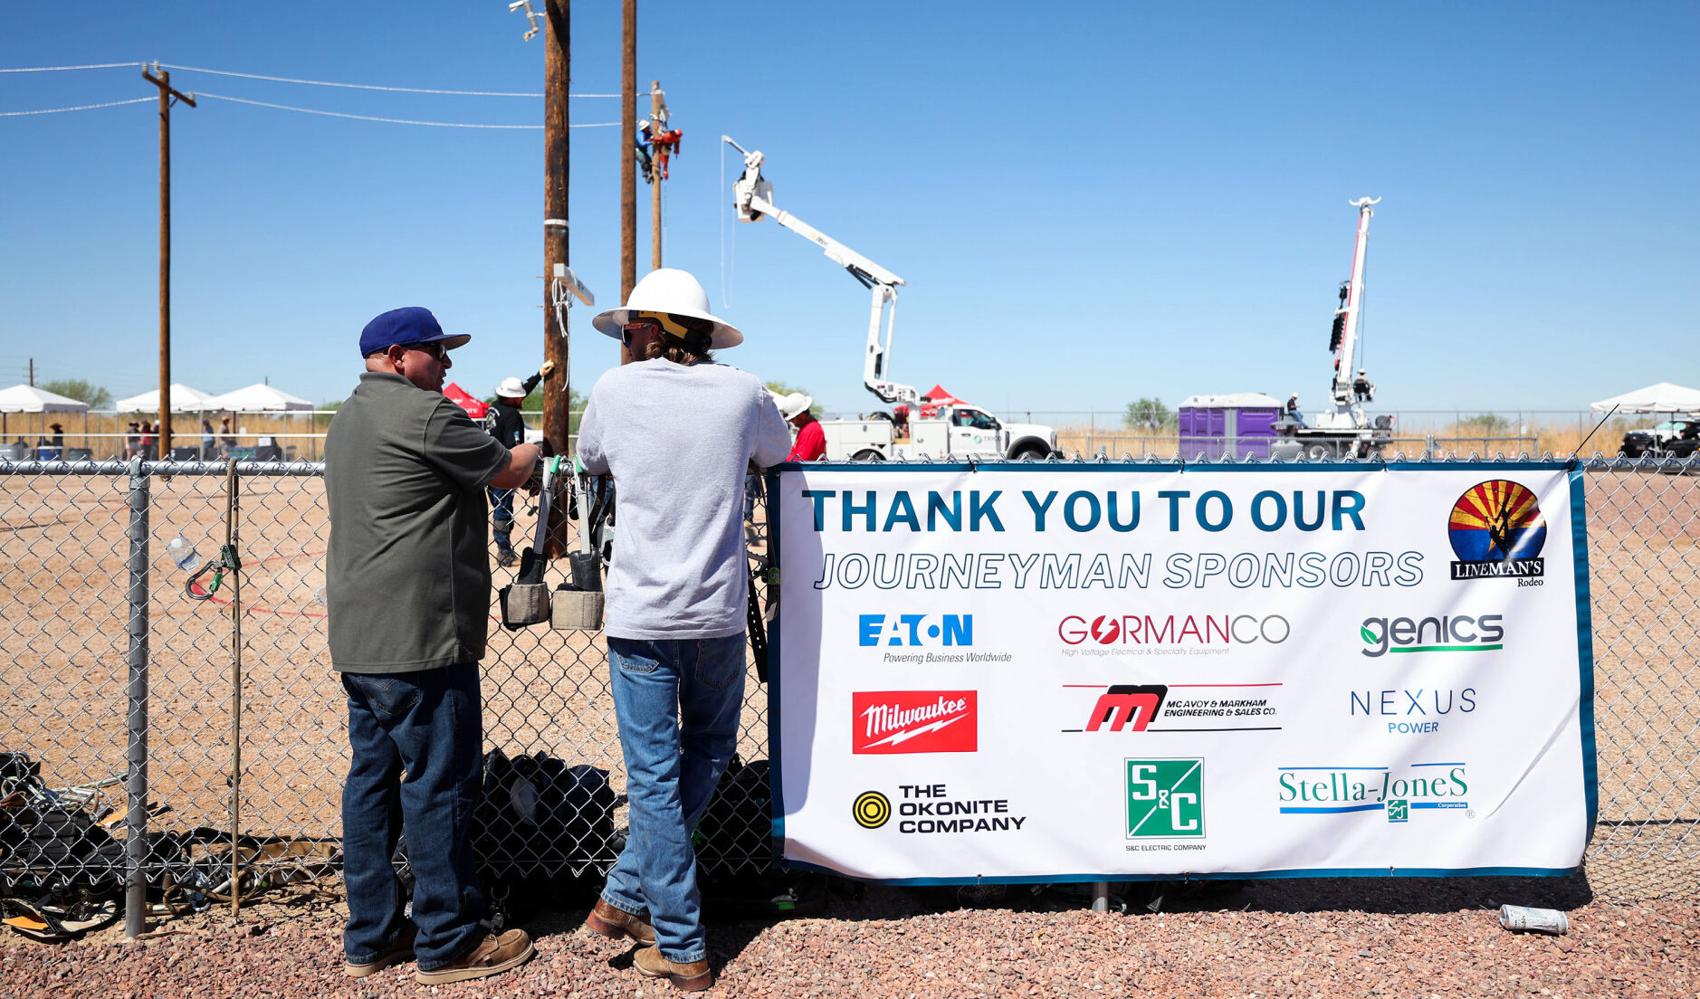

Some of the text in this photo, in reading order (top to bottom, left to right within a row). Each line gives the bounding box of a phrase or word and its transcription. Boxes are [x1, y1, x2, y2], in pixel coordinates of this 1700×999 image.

[801, 489, 1366, 532] THANK YOU TO OUR
[814, 550, 1424, 590] JOURNEYMAN SPONSORS
[1455, 561, 1542, 580] LINEMAN'S
[1517, 577, 1544, 588] Rodeo
[859, 614, 973, 647] EATON
[1058, 614, 1291, 645] GORMANCO
[883, 652, 1012, 664] Powering Business Worldwide
[1080, 648, 1110, 656] Voltage
[1189, 648, 1231, 656] Equipment
[1183, 700, 1210, 708] AVOY
[1219, 699, 1268, 708] MARKHAM
[1350, 687, 1477, 717] NEXUS
[859, 695, 968, 738] Milwaukee
[1164, 708, 1225, 717] ENGINEERING
[1234, 708, 1261, 716] SALES
[1388, 721, 1439, 734] POWER
[899, 783, 947, 799] THE
[899, 799, 1009, 817] OKONITE
[899, 816, 1027, 834] COMPANY
[1125, 843, 1207, 852] S&C ELECTRIC COMPANY
